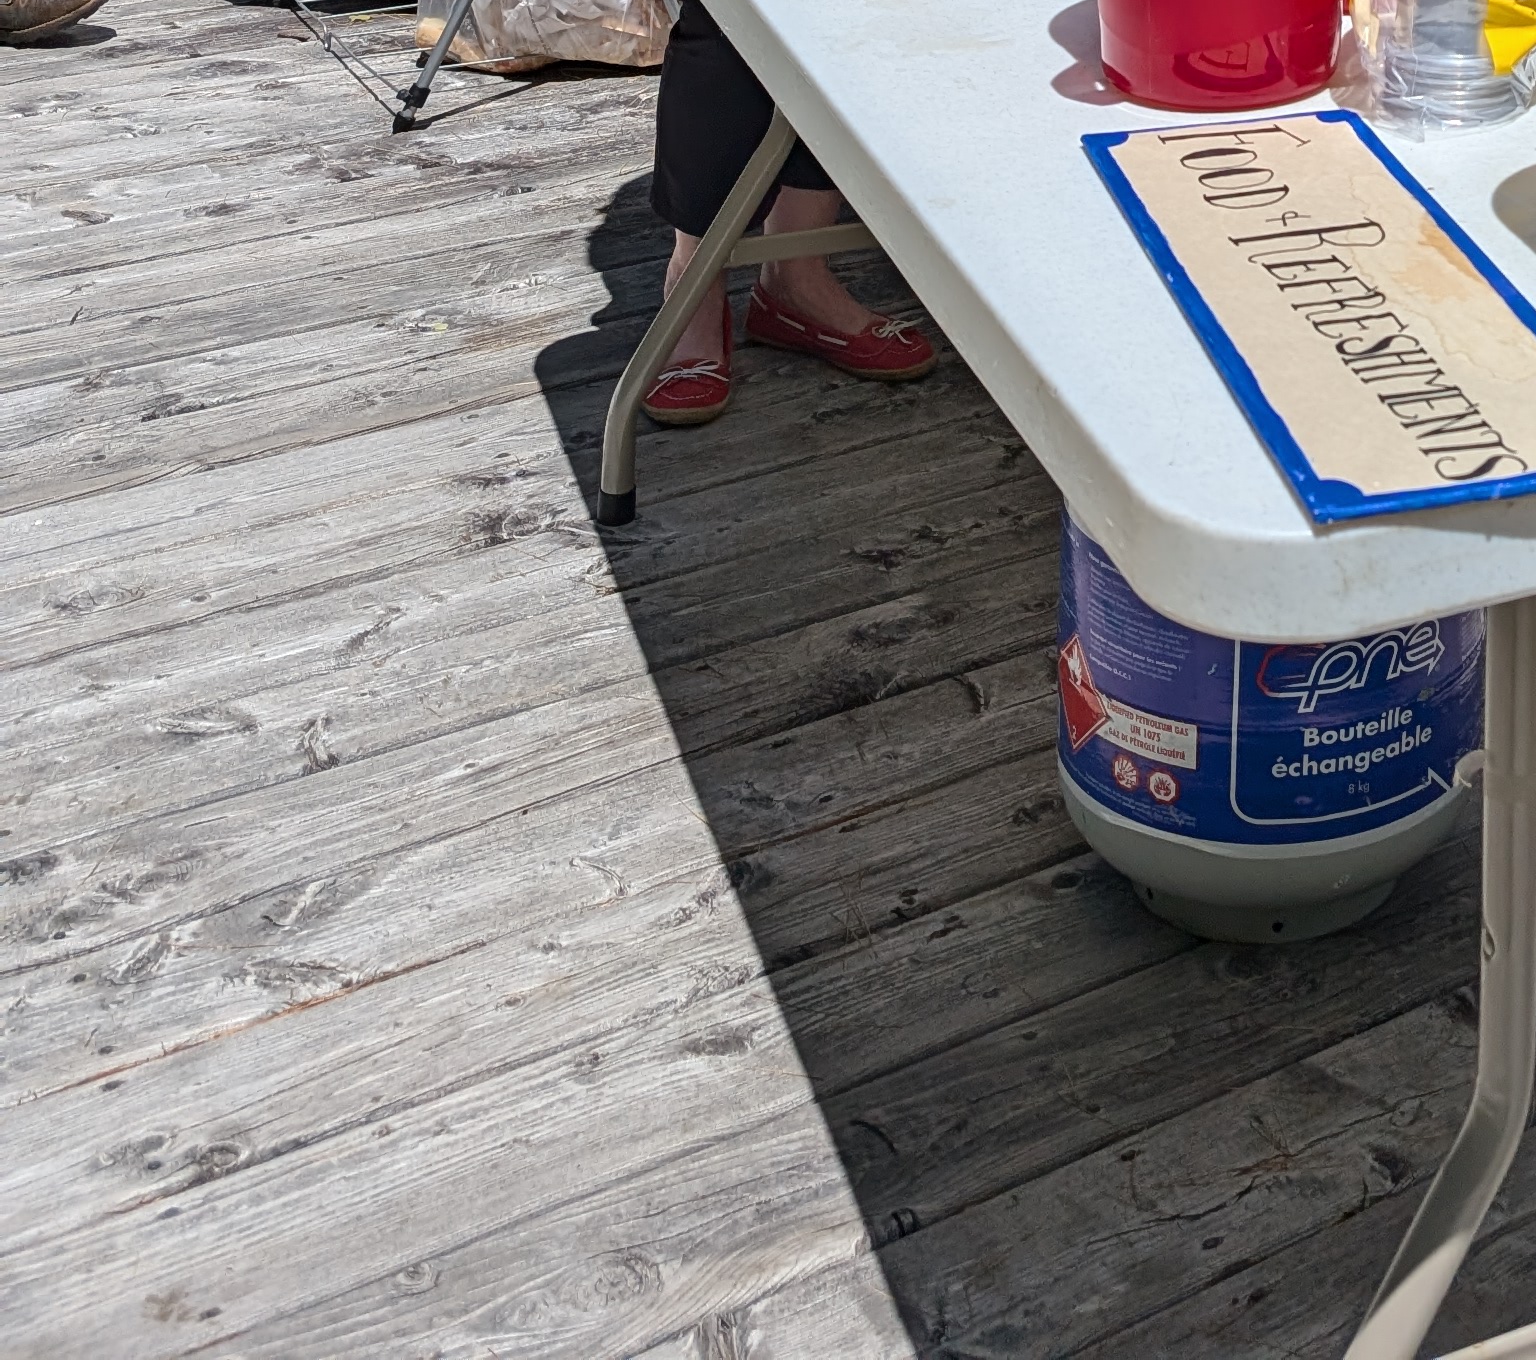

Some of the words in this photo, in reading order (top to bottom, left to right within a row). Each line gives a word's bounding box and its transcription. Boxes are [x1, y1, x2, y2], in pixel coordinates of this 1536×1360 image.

[1158, 124, 1312, 210] FOOD
[1227, 216, 1529, 481] REFRESHMENTS
[1129, 723, 1142, 736] UN
[1143, 729, 1162, 743] 1075
[1174, 724, 1189, 737] GAS
[1303, 706, 1413, 748] Bouteille
[1271, 725, 1432, 779] échangeable
[1358, 780, 1370, 793] kg
